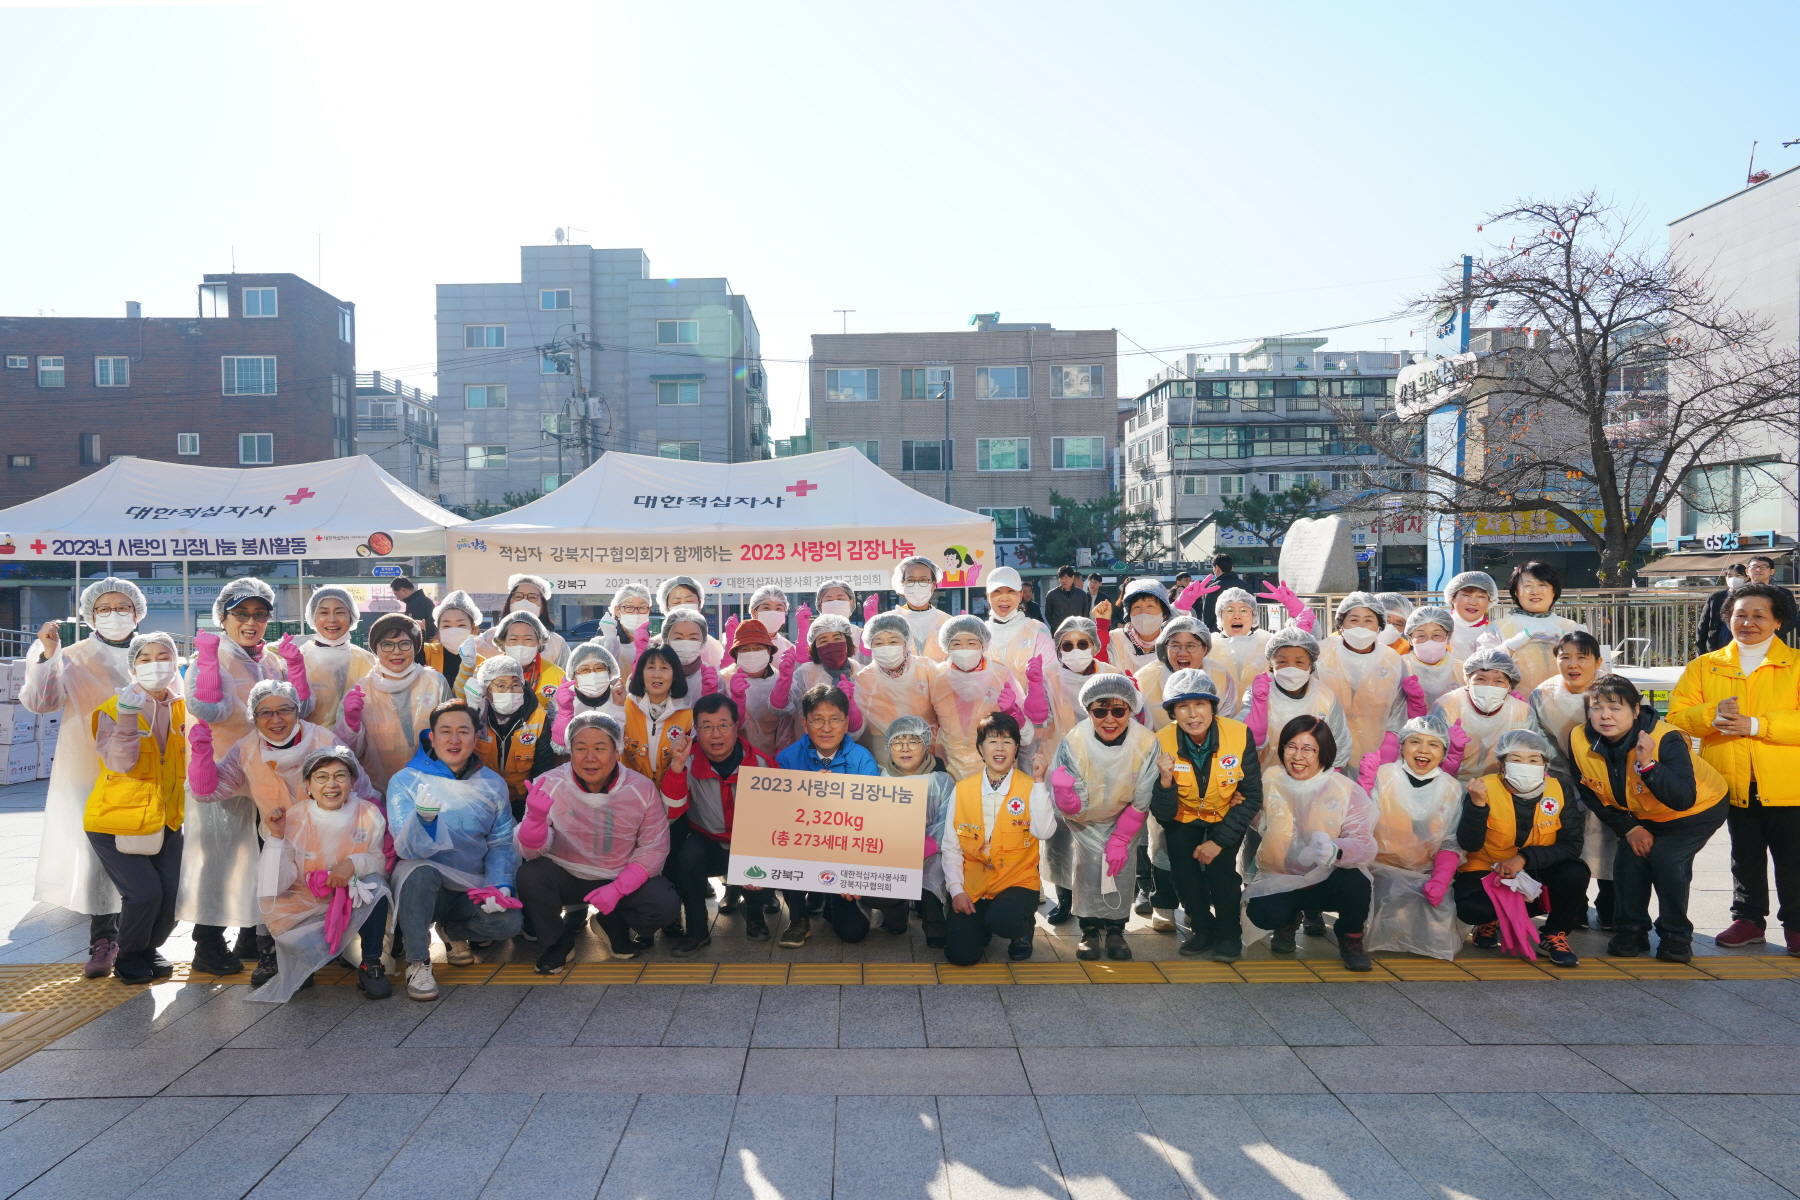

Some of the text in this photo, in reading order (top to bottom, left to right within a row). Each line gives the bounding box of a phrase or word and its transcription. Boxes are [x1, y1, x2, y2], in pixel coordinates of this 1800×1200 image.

[633, 494, 786, 509] 대한적십자사
[124, 504, 278, 520] 대한적십자사
[52, 537, 308, 556] 2023년 사랑의 김장나눔 봉사활동
[1704, 532, 1740, 550] GS25
[498, 538, 916, 562] 적십자 강북지구협의회가 함께하는 2023 사랑의 김장나눔
[557, 580, 586, 590] 강북구
[656, 578, 668, 588] 2
[726, 576, 812, 588] 대한적십자사봉사회
[750, 776, 914, 804] 2023 사랑의 김장나눔
[795, 808, 864, 832] 2,320kg
[772, 830, 884, 854] (총 273세대 지원)
[770, 869, 804, 881] 강북구
[840, 870, 908, 882] 대한적십자사봉사회
[840, 880, 892, 892] 강북지구협의회
